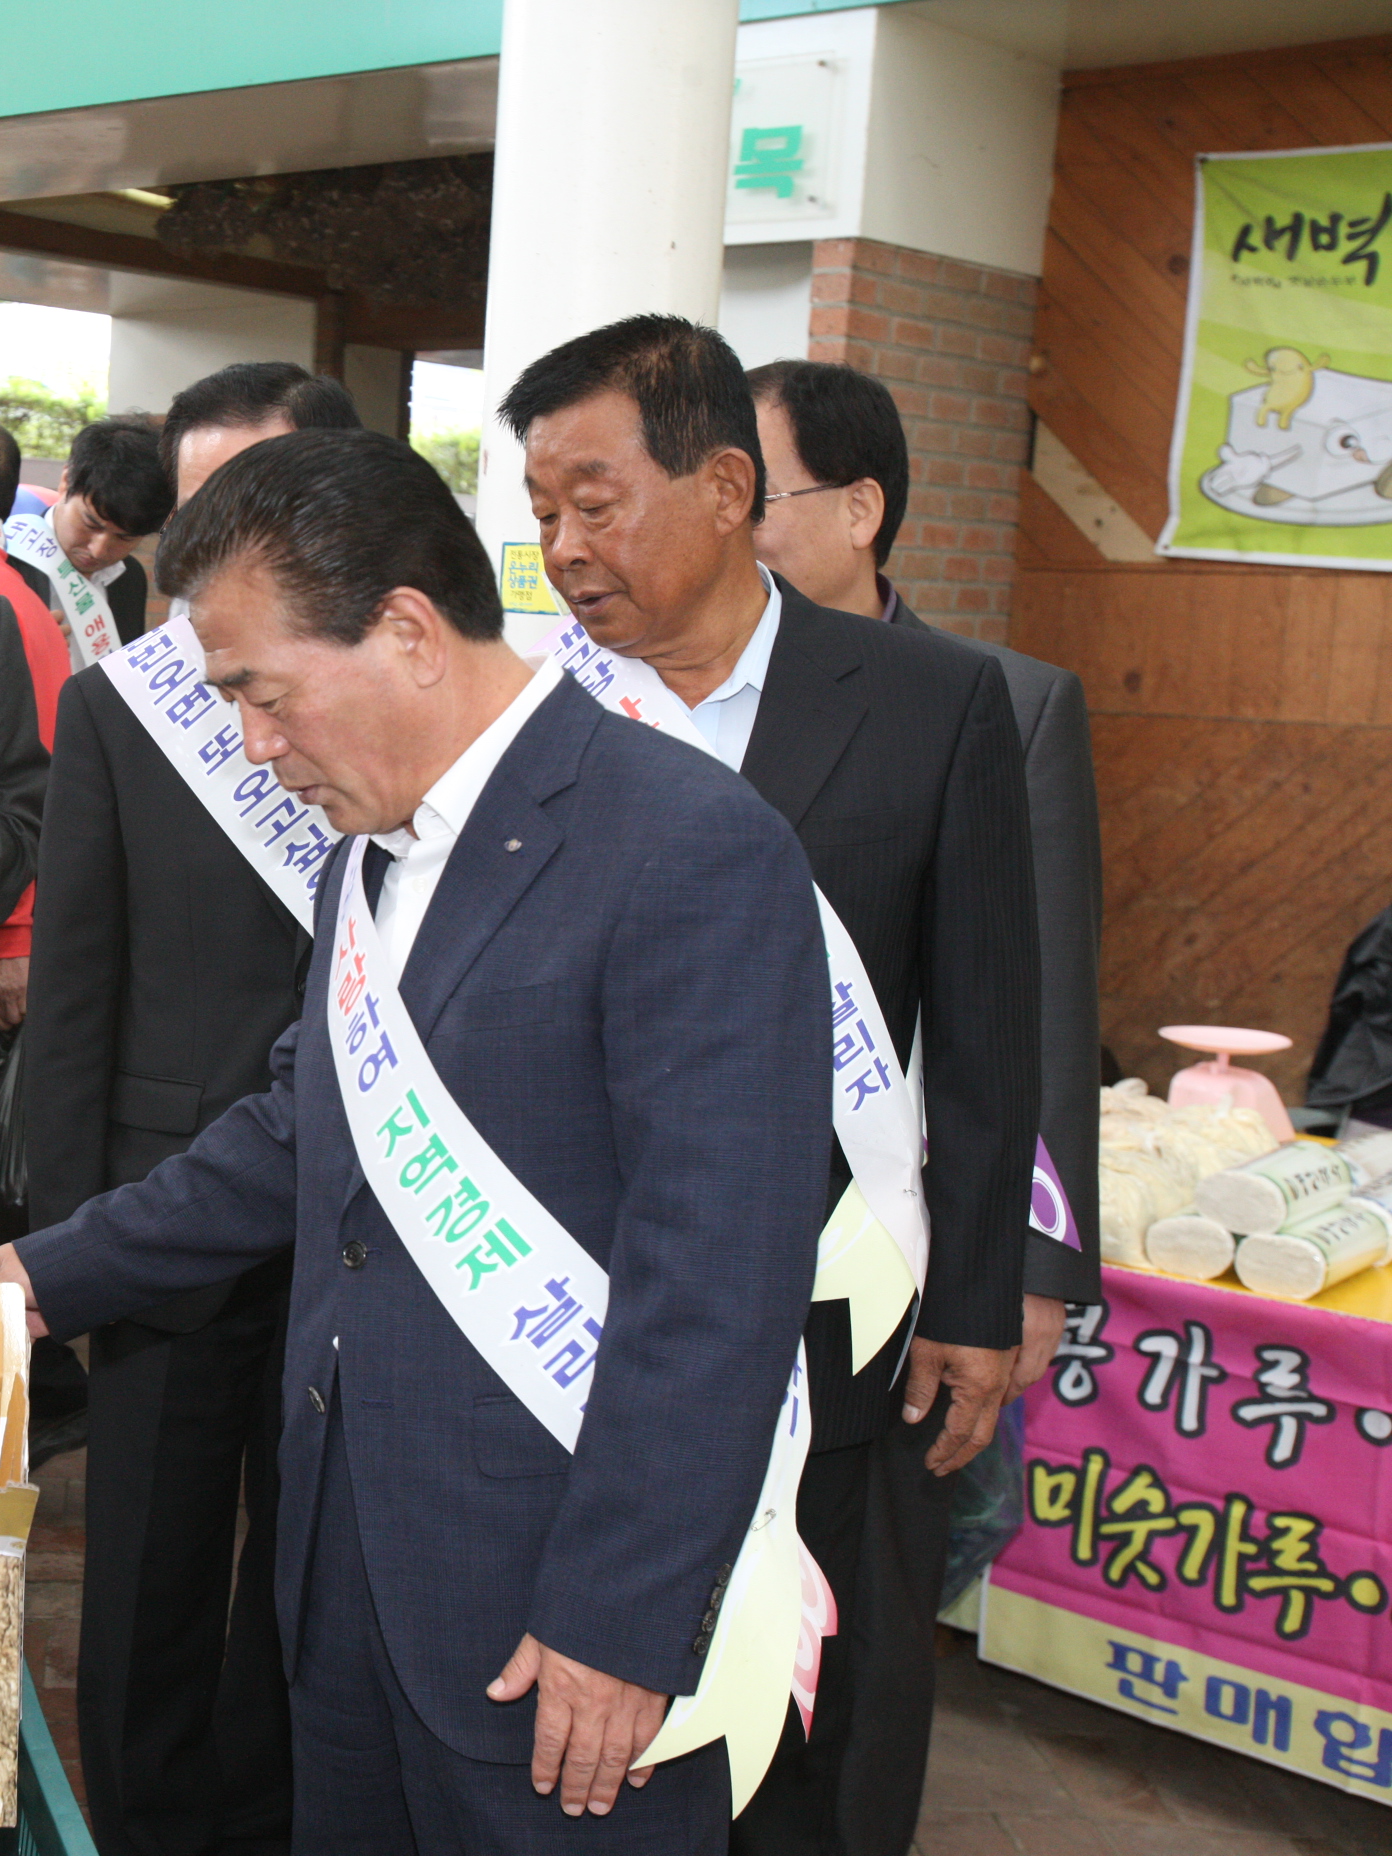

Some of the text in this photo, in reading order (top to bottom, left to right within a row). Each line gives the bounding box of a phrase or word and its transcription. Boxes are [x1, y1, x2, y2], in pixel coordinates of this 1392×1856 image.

[1230, 191, 1392, 287] 새벽
[6, 521, 58, 558] 내고장
[84, 614, 114, 656] 애용
[120, 626, 217, 730] 번오면
[197, 723, 244, 776] 또
[376, 1087, 534, 1291] 지역경제
[509, 1276, 605, 1414] 살리
